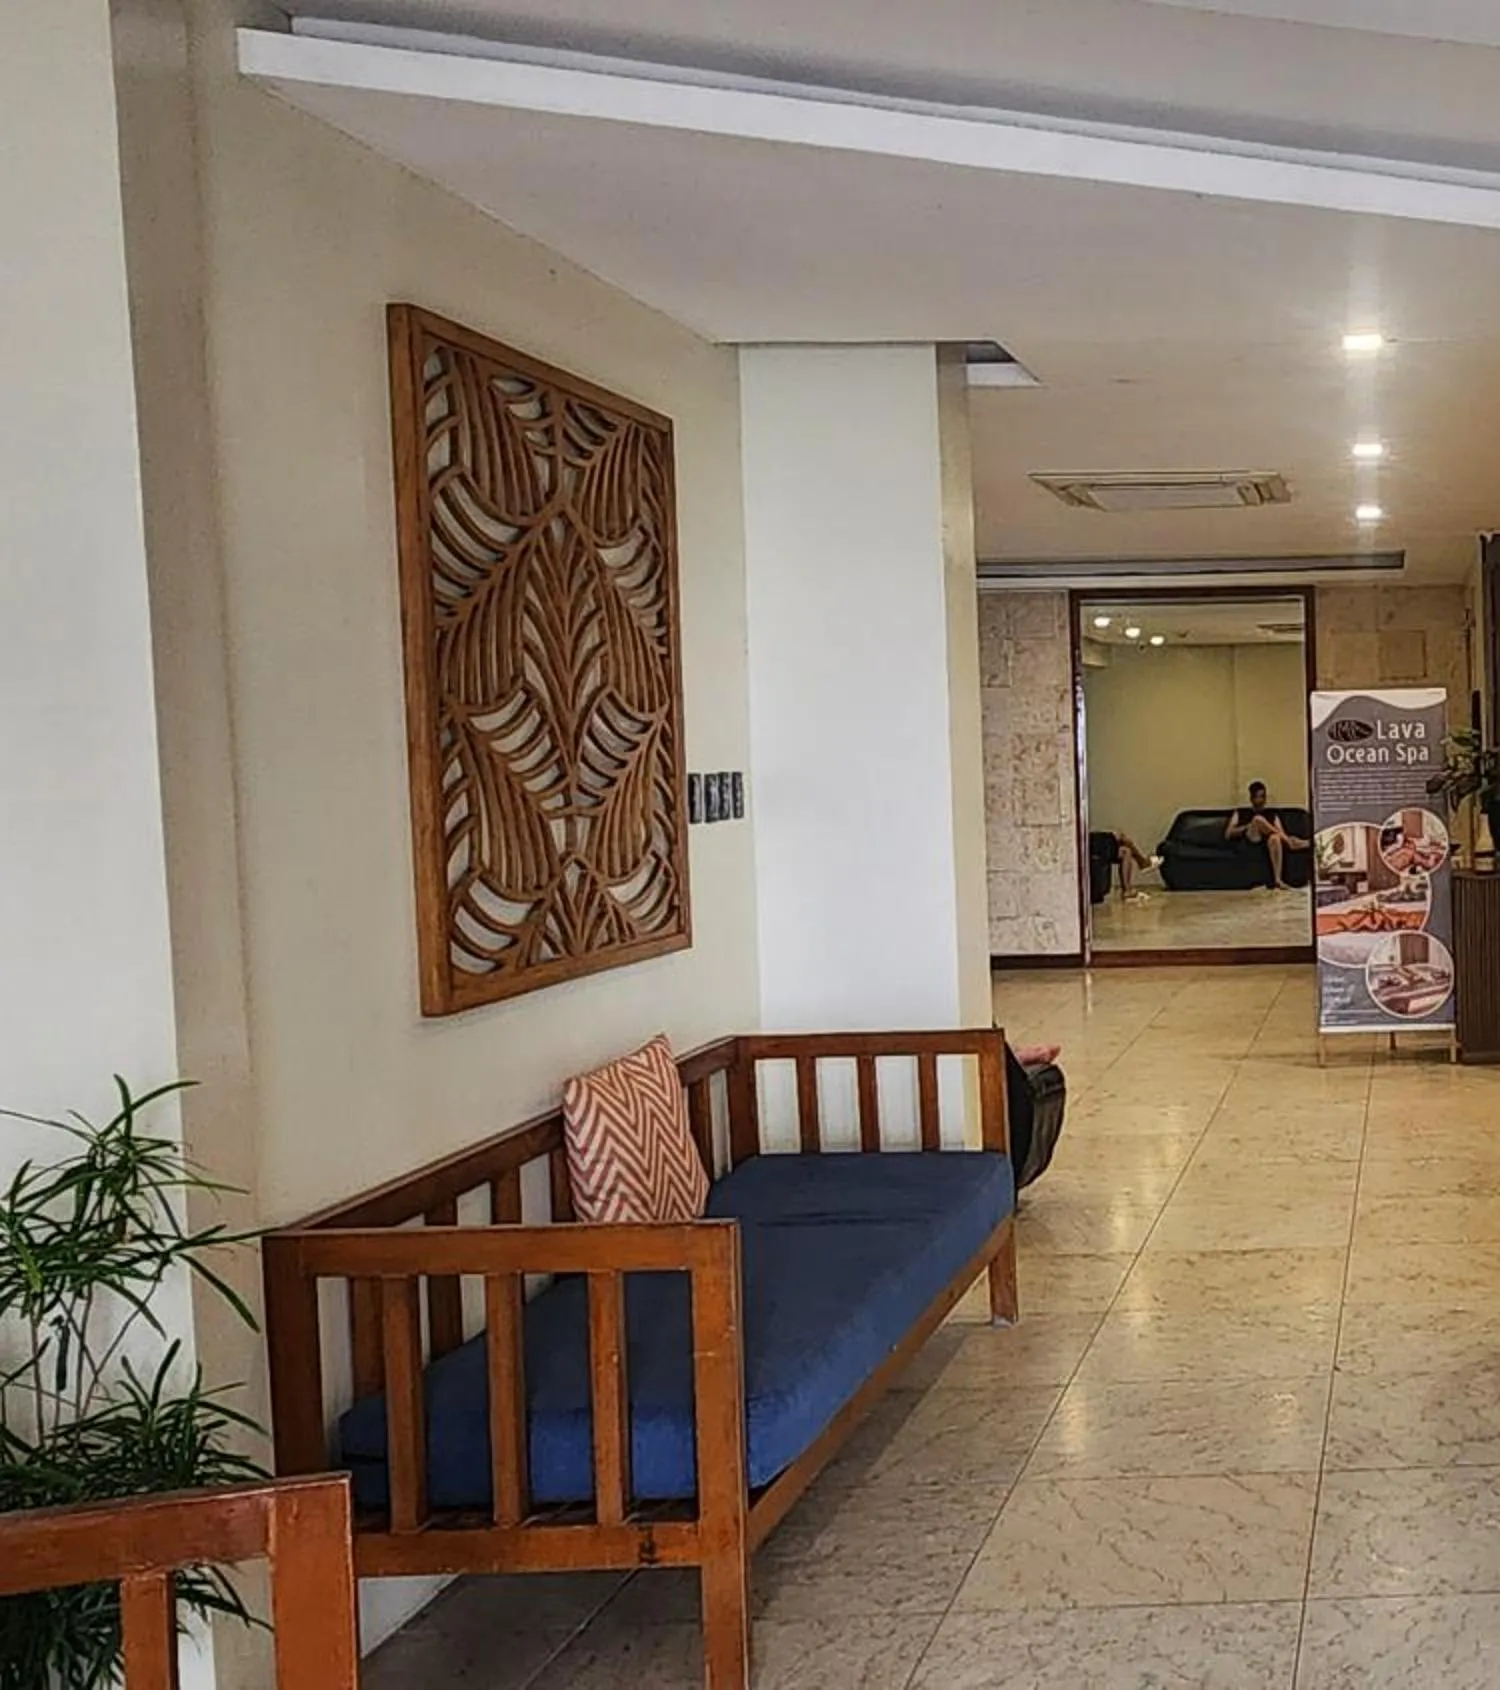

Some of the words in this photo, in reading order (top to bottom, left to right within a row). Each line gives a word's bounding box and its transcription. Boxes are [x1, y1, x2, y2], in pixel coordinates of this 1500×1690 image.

[1377, 719, 1426, 740] Lava
[1326, 744, 1389, 765] Ocean
[1395, 743, 1430, 765] Spa
